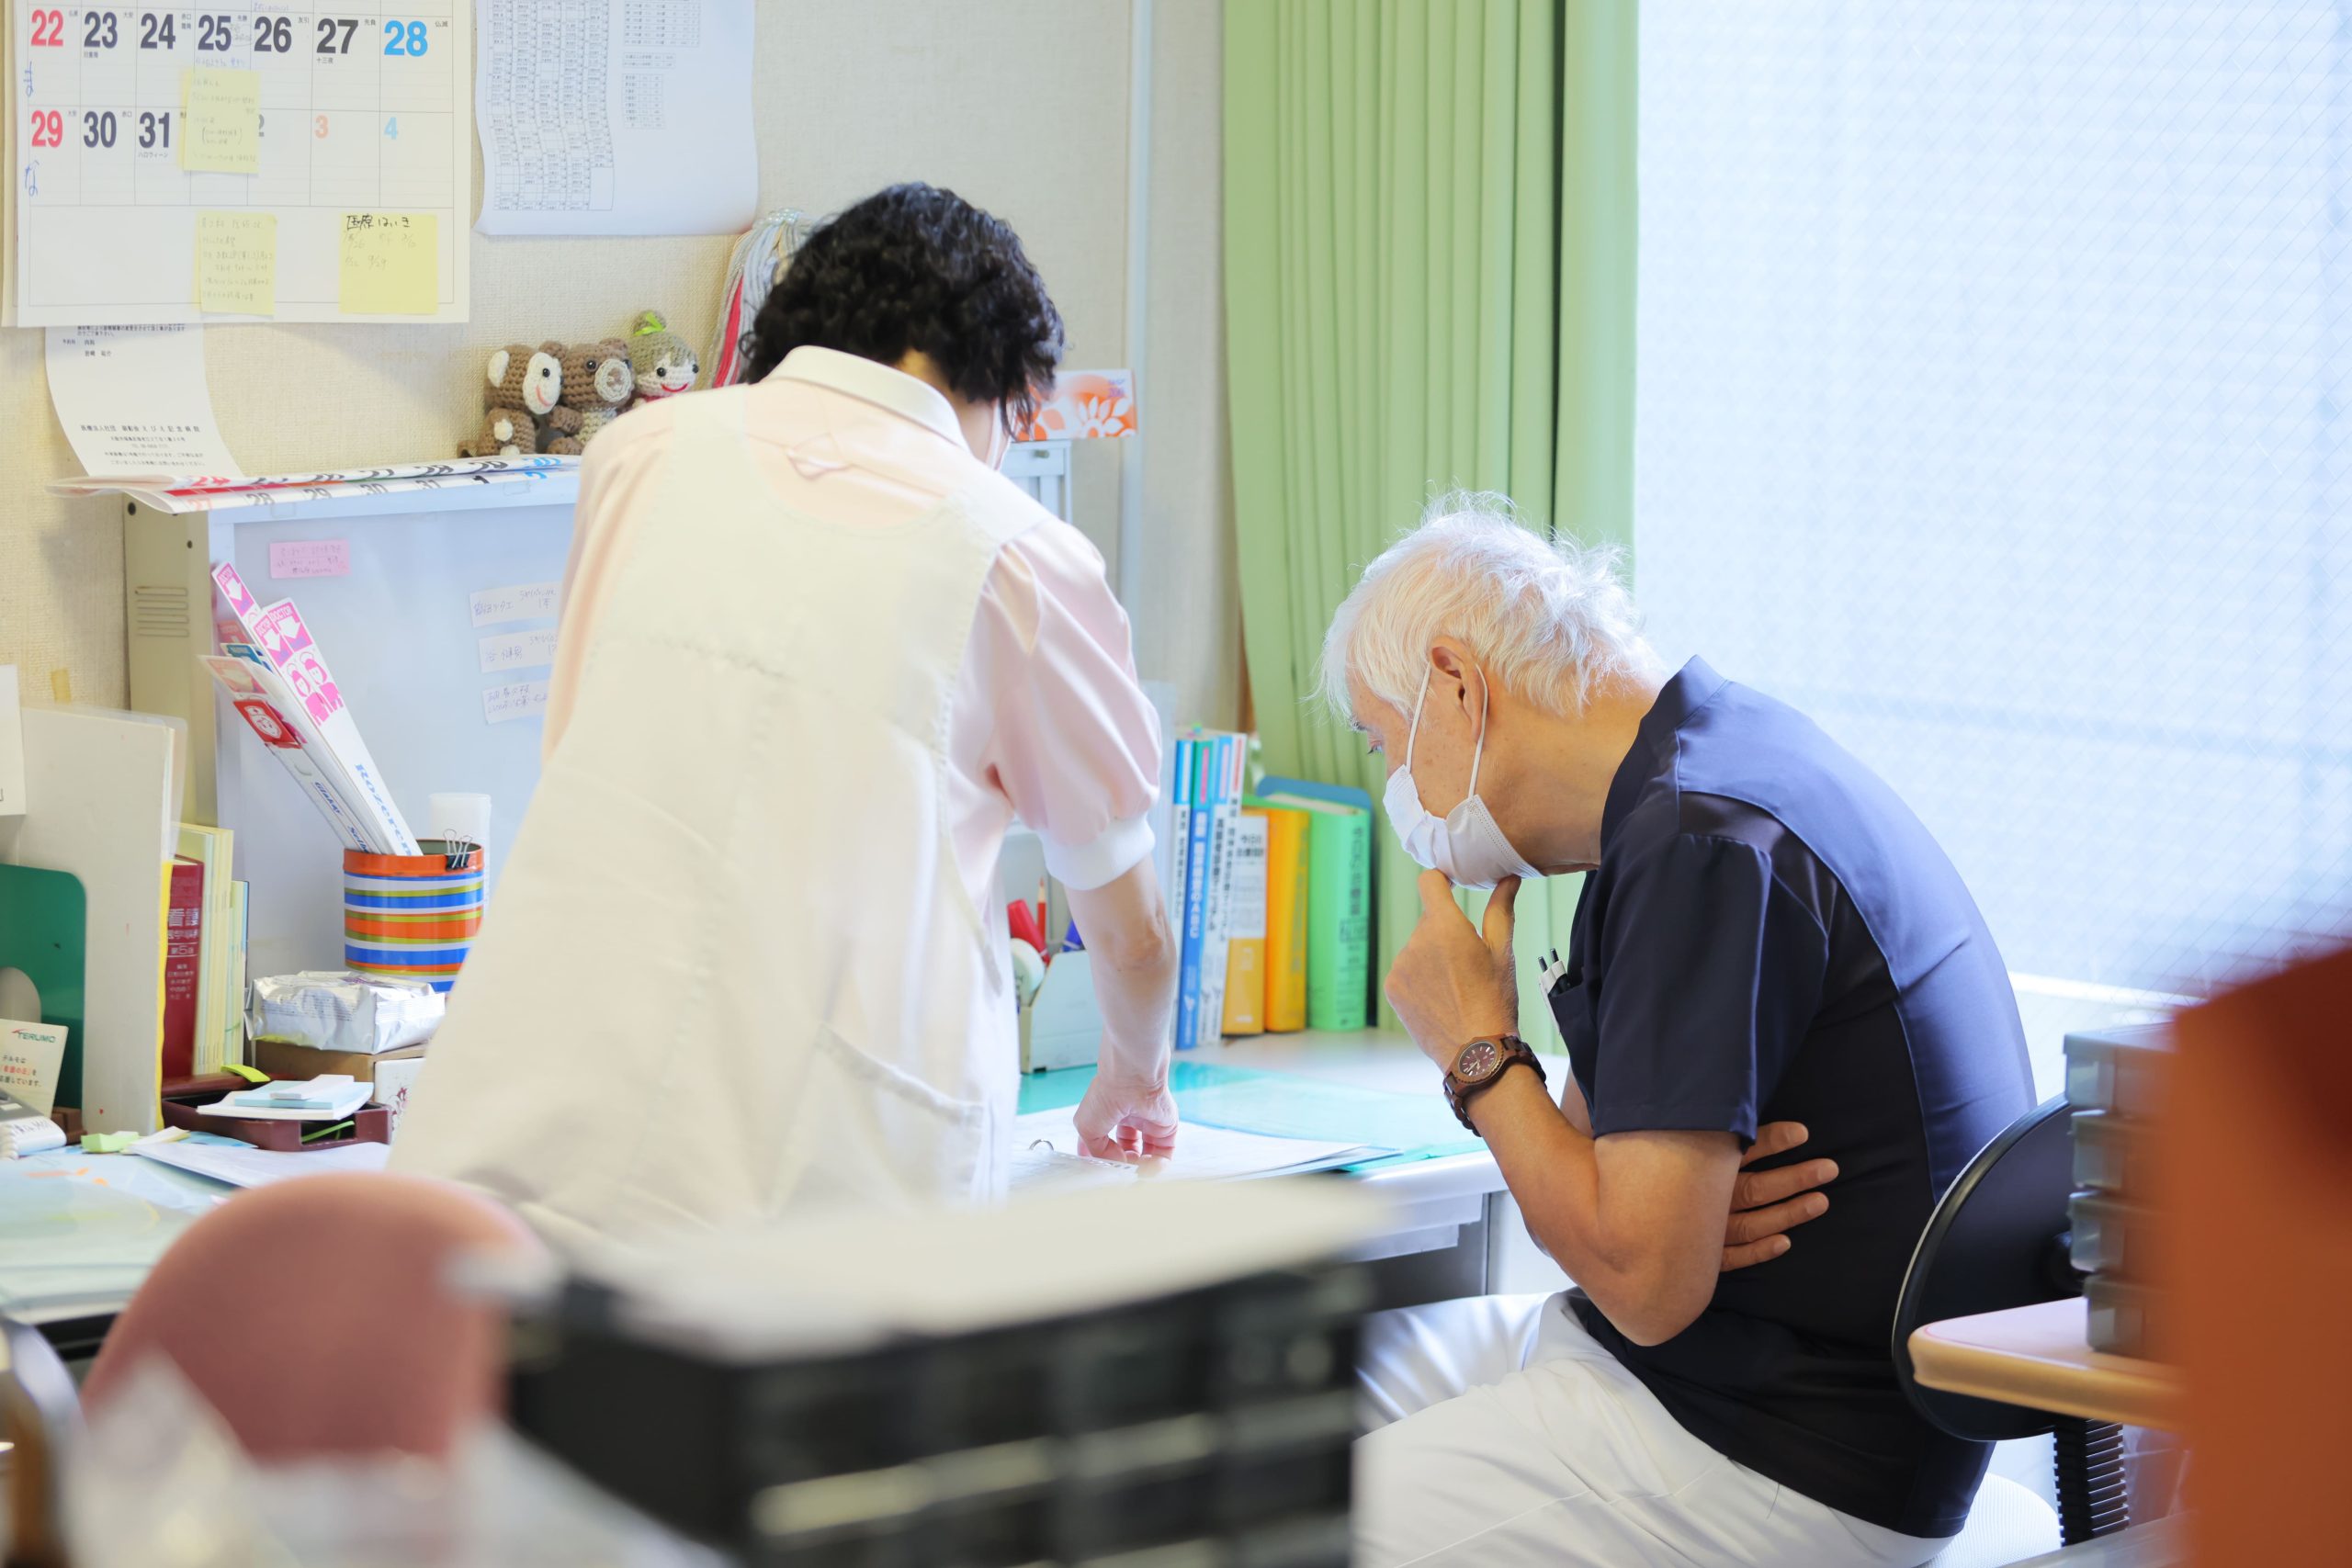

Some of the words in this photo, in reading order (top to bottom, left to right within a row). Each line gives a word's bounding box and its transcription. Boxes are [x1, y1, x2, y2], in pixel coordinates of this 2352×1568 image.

[31, 10, 63, 47] 22
[84, 12, 118, 49] 23
[141, 13, 175, 50] 24
[198, 15, 232, 51] 25
[254, 17, 292, 53] 26
[316, 18, 358, 54] 27
[384, 20, 428, 56] 28
[31, 110, 62, 148] 29
[84, 111, 117, 148] 30
[139, 112, 170, 148] 31
[315, 115, 328, 139] 3
[384, 118, 399, 140] 4
[267, 604, 293, 622] DOCTOR
[17, 1032, 56, 1043] TERUMO
